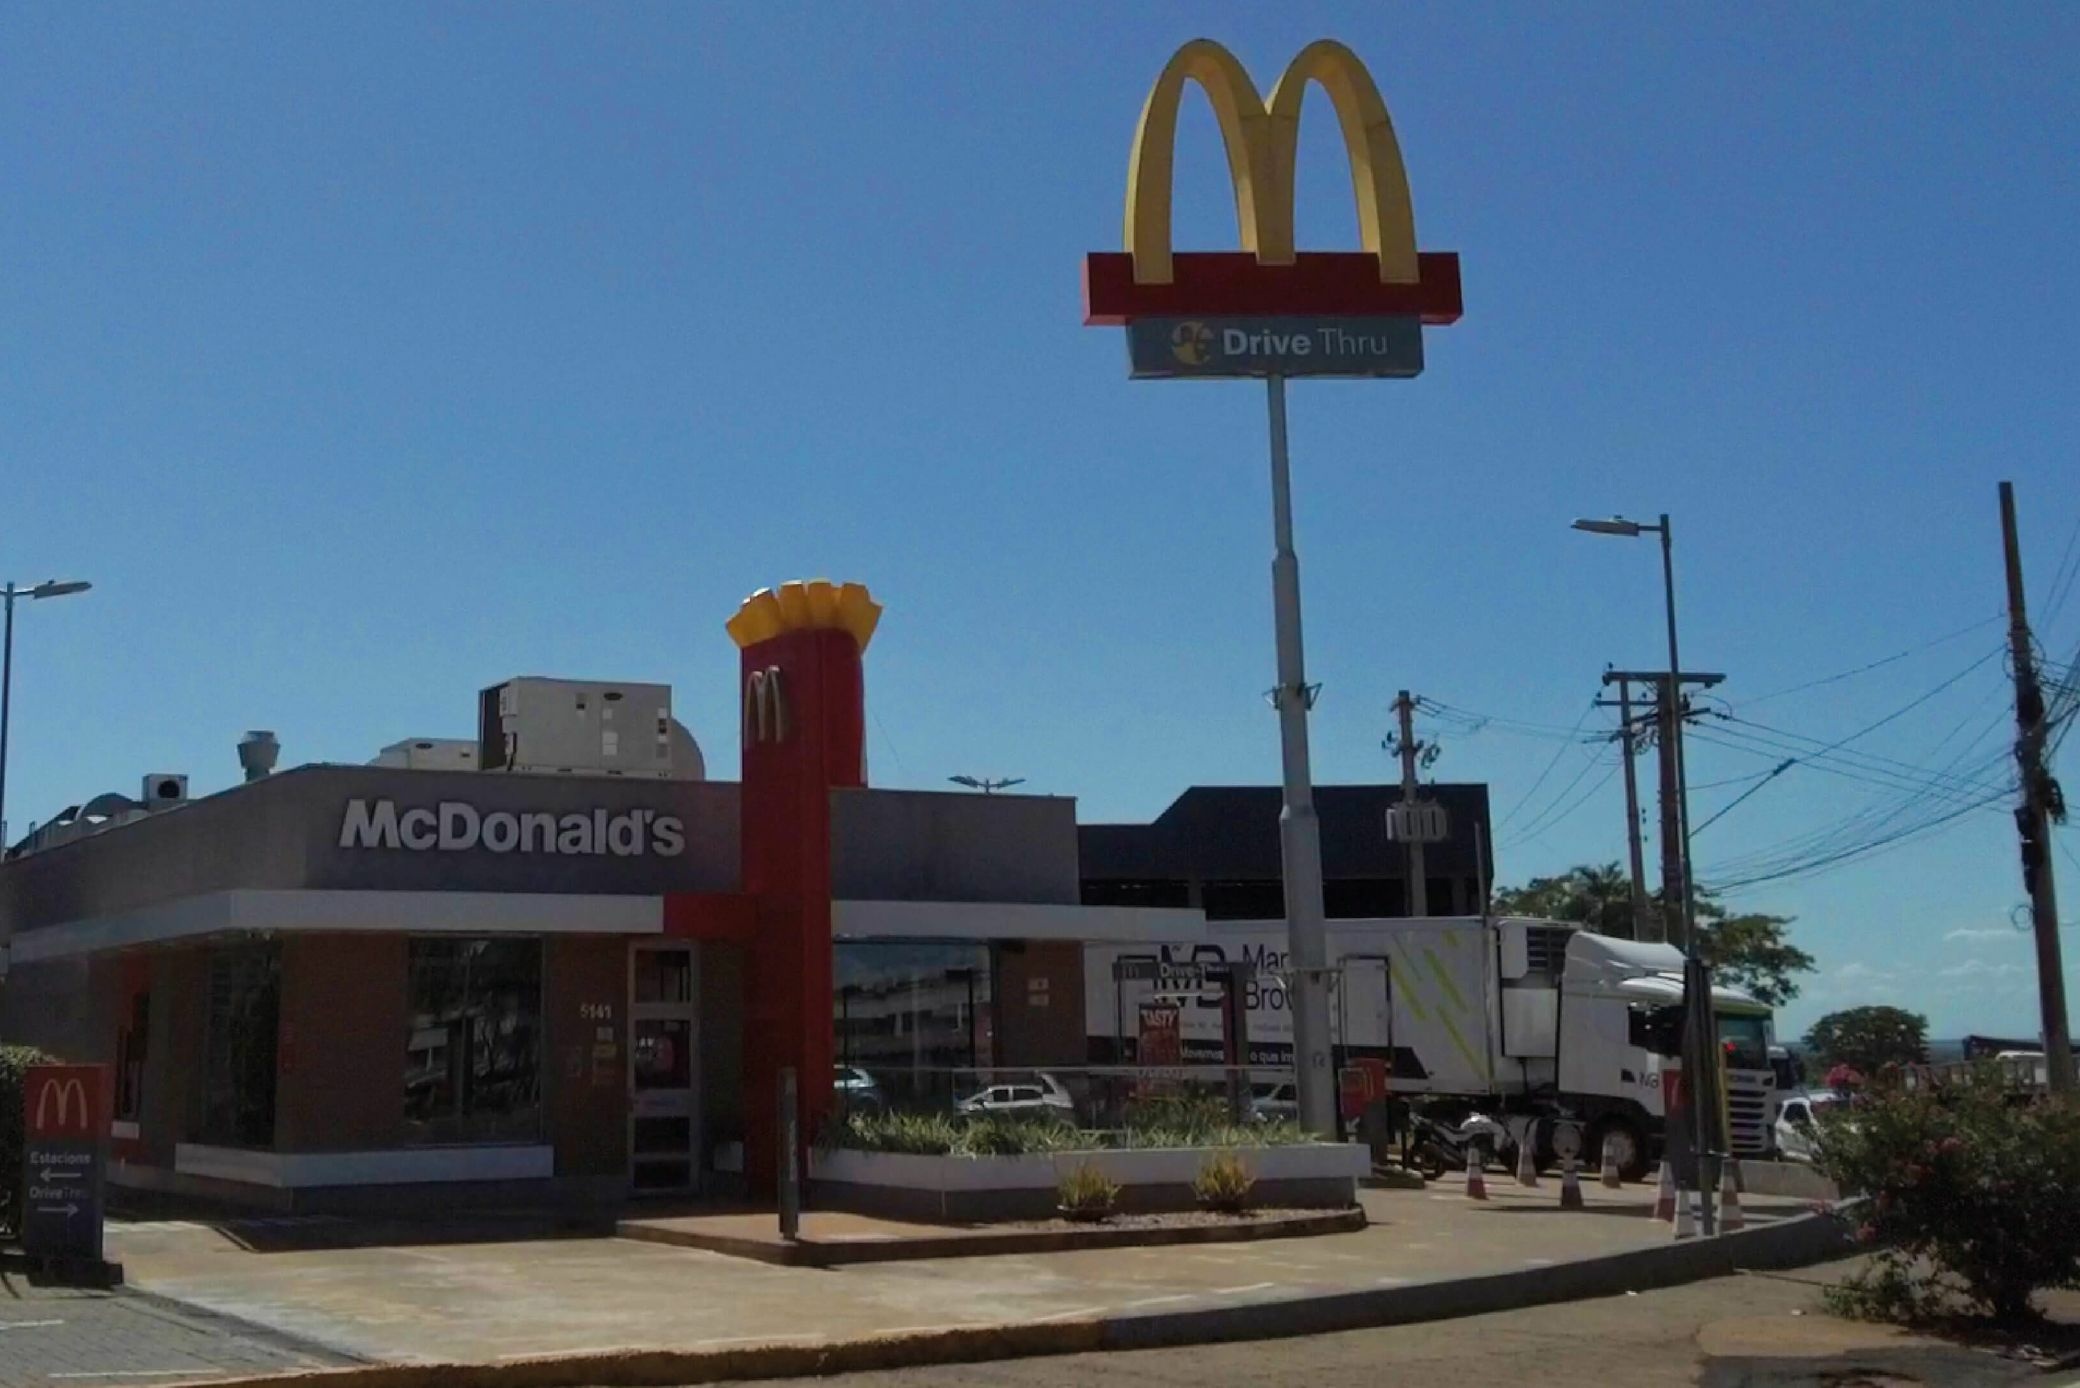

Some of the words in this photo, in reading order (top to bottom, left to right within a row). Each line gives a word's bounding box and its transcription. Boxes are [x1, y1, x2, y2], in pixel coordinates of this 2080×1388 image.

[1223, 328, 1313, 356] Drive
[1316, 328, 1389, 356] Thru
[338, 798, 687, 857] McDonald's
[1242, 944, 1289, 970] Mar
[1141, 1009, 1177, 1029] TASTY
[28, 1186, 63, 1200] Drive
